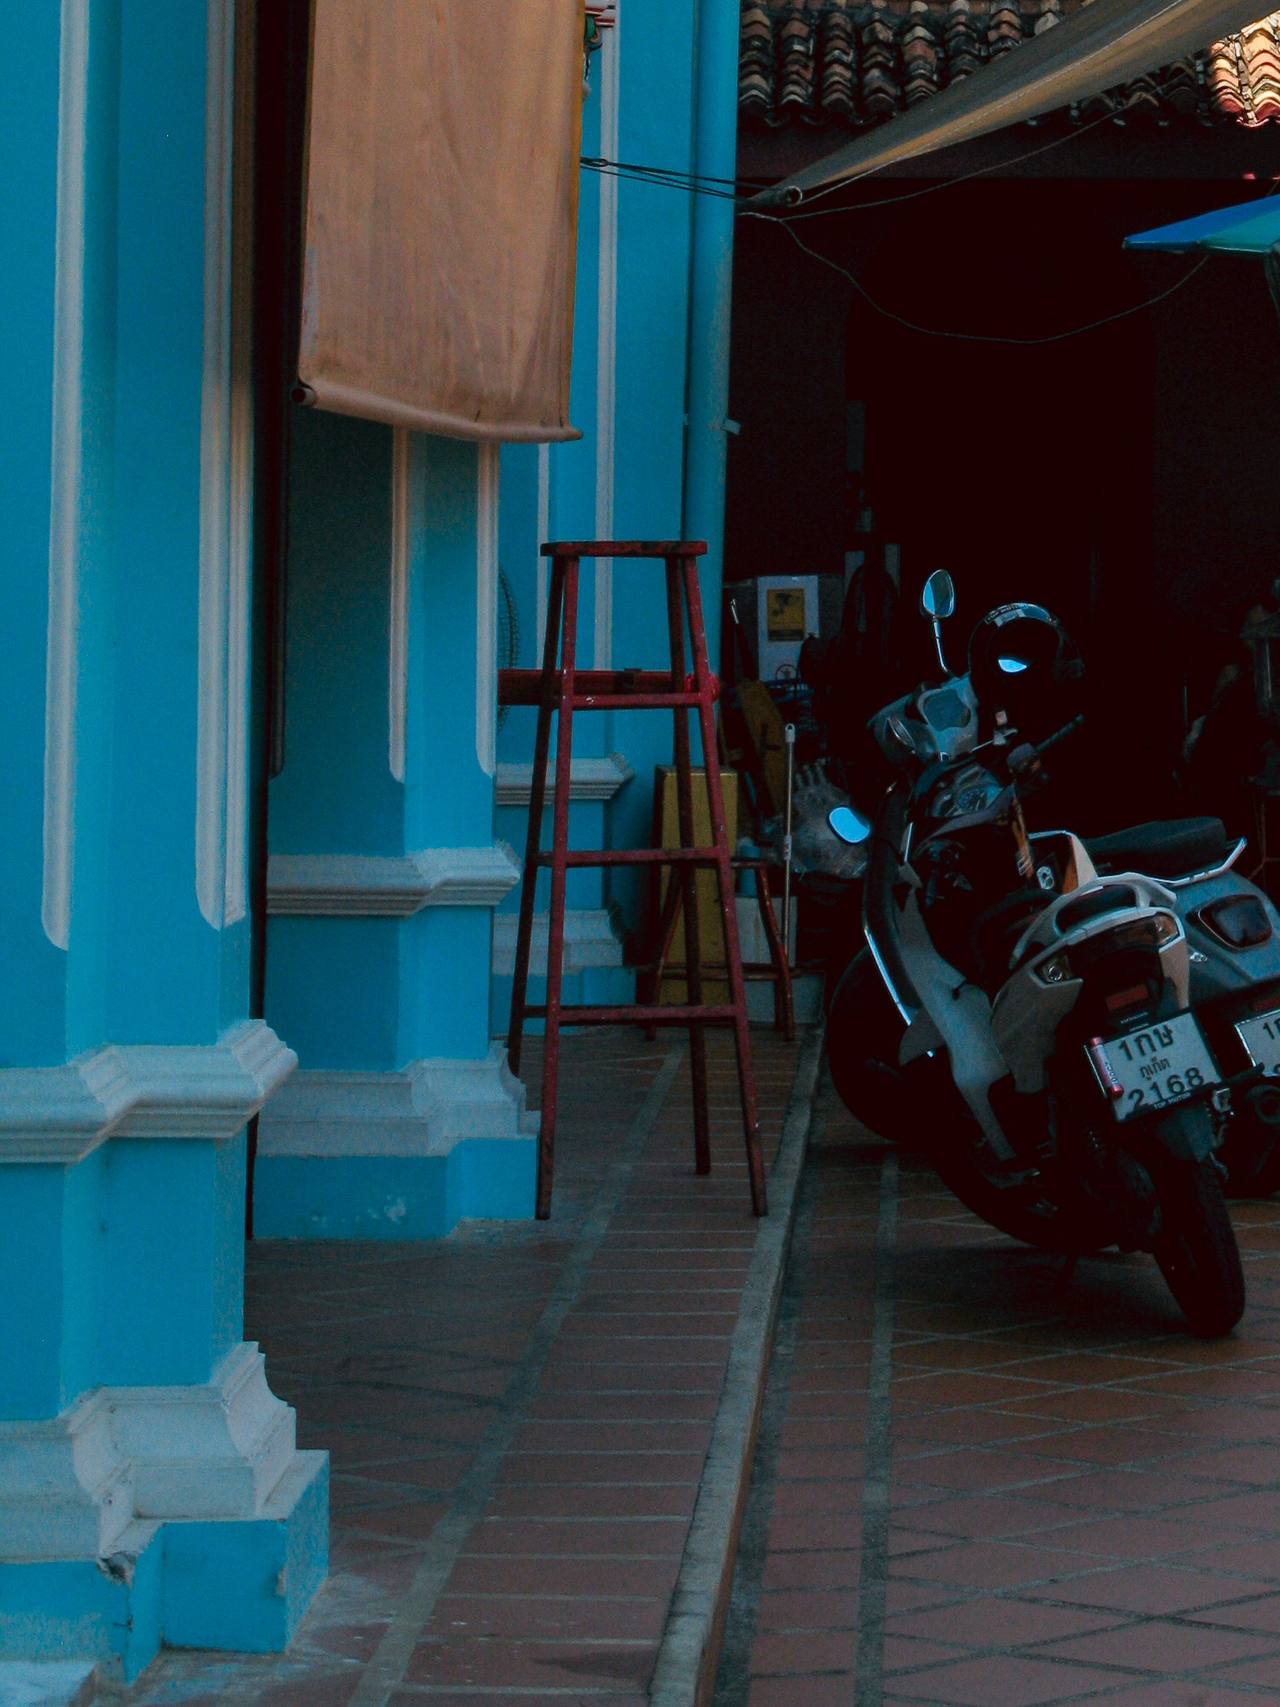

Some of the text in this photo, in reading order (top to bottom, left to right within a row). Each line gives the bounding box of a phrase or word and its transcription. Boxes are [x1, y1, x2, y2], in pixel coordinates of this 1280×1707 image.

[1140, 1055, 1172, 1081] ภูเก็ต
[1127, 1066, 1204, 1110] 2168
